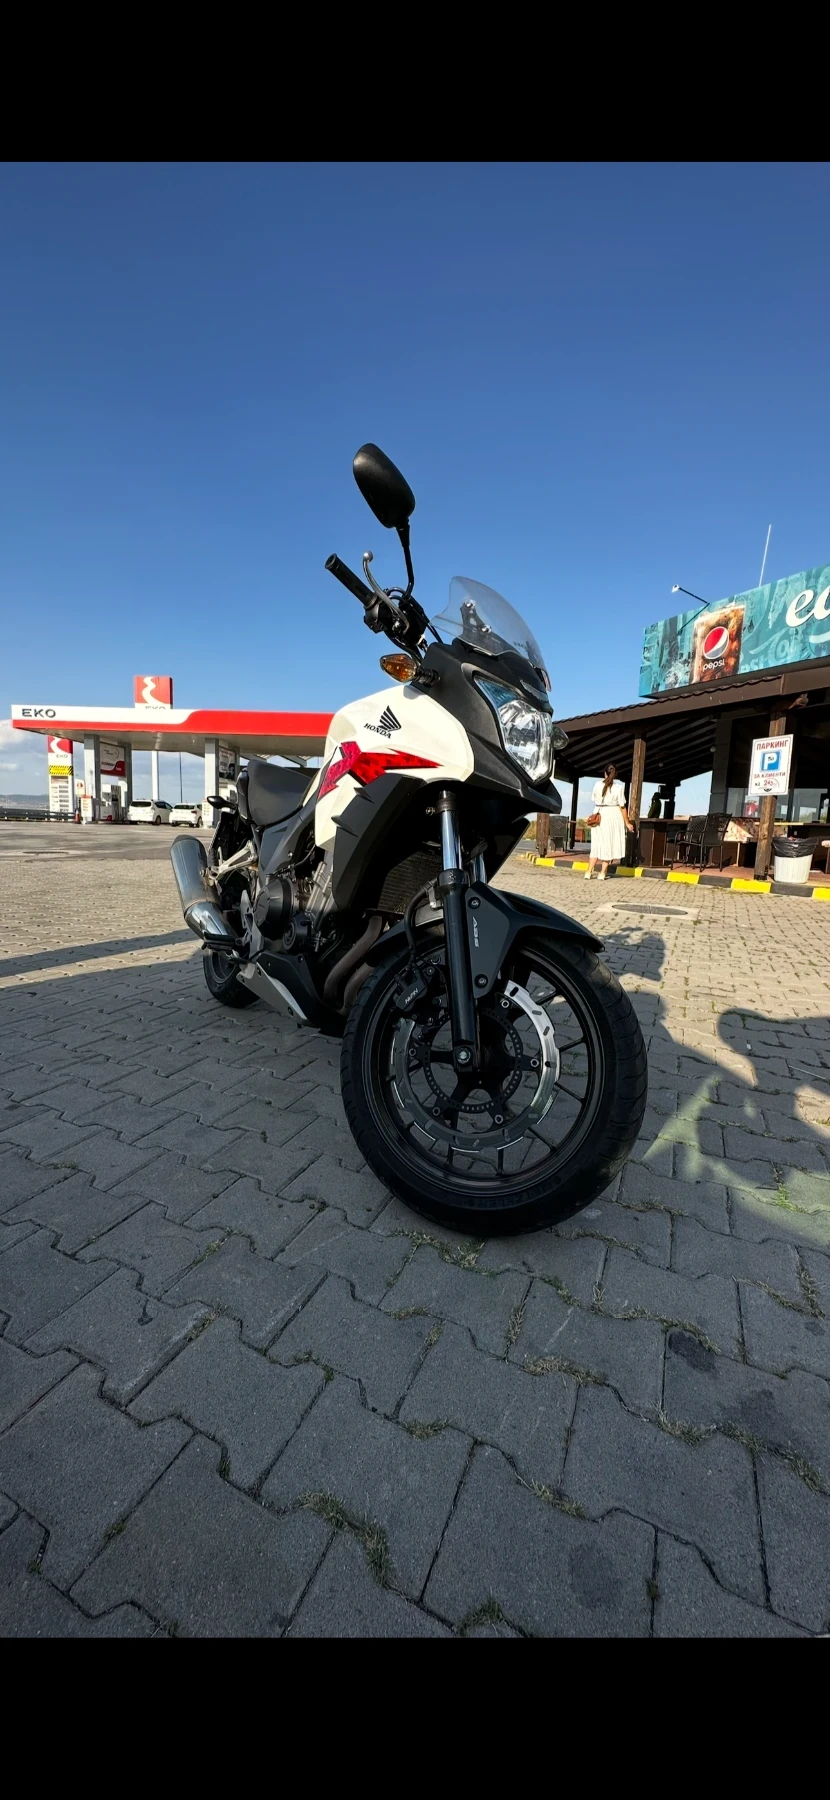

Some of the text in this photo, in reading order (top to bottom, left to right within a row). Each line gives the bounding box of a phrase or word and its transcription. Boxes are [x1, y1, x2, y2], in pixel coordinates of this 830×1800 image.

[703, 659, 725, 672] pepsi
[21, 708, 56, 718] EKO
[363, 723, 392, 739] HONDA
[757, 740, 789, 751] ПАРКИНГ
